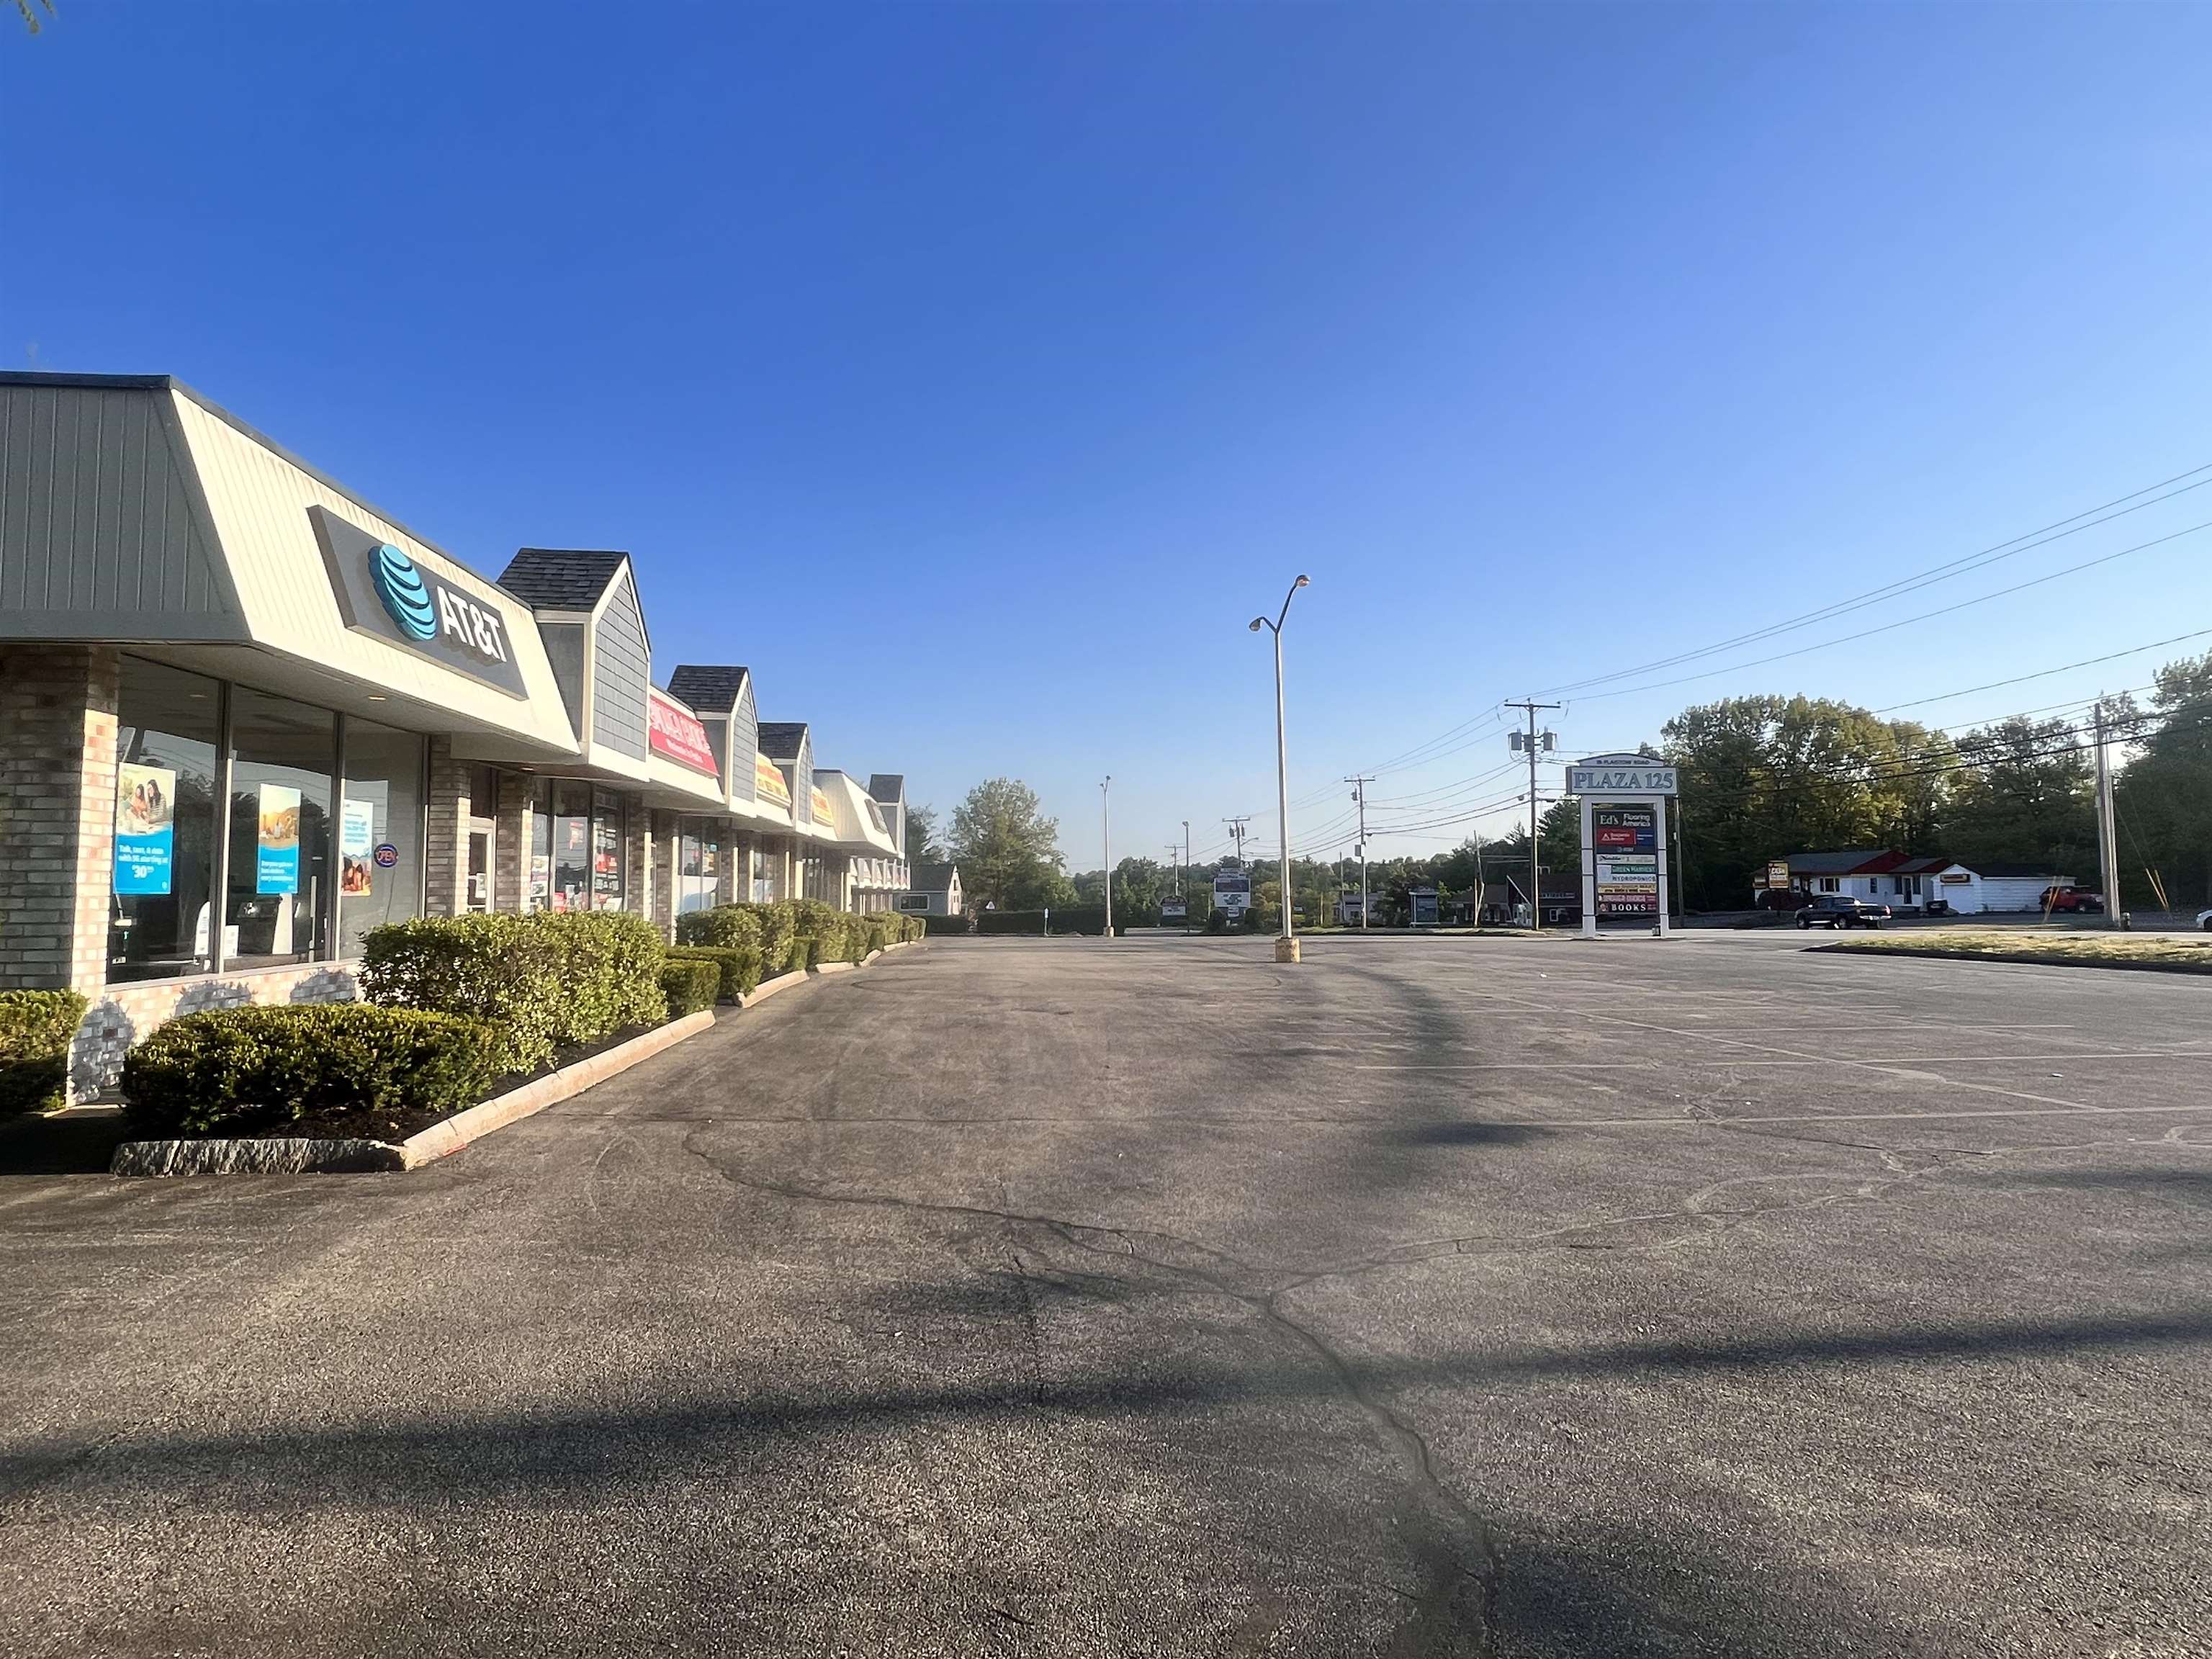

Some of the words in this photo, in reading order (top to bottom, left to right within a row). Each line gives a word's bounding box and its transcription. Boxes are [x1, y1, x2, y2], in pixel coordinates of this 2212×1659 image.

[437, 585, 507, 662] AT&T
[1573, 772, 1642, 788] PLAZA
[1645, 773, 1673, 788] 125
[1600, 814, 1619, 825] Ed's
